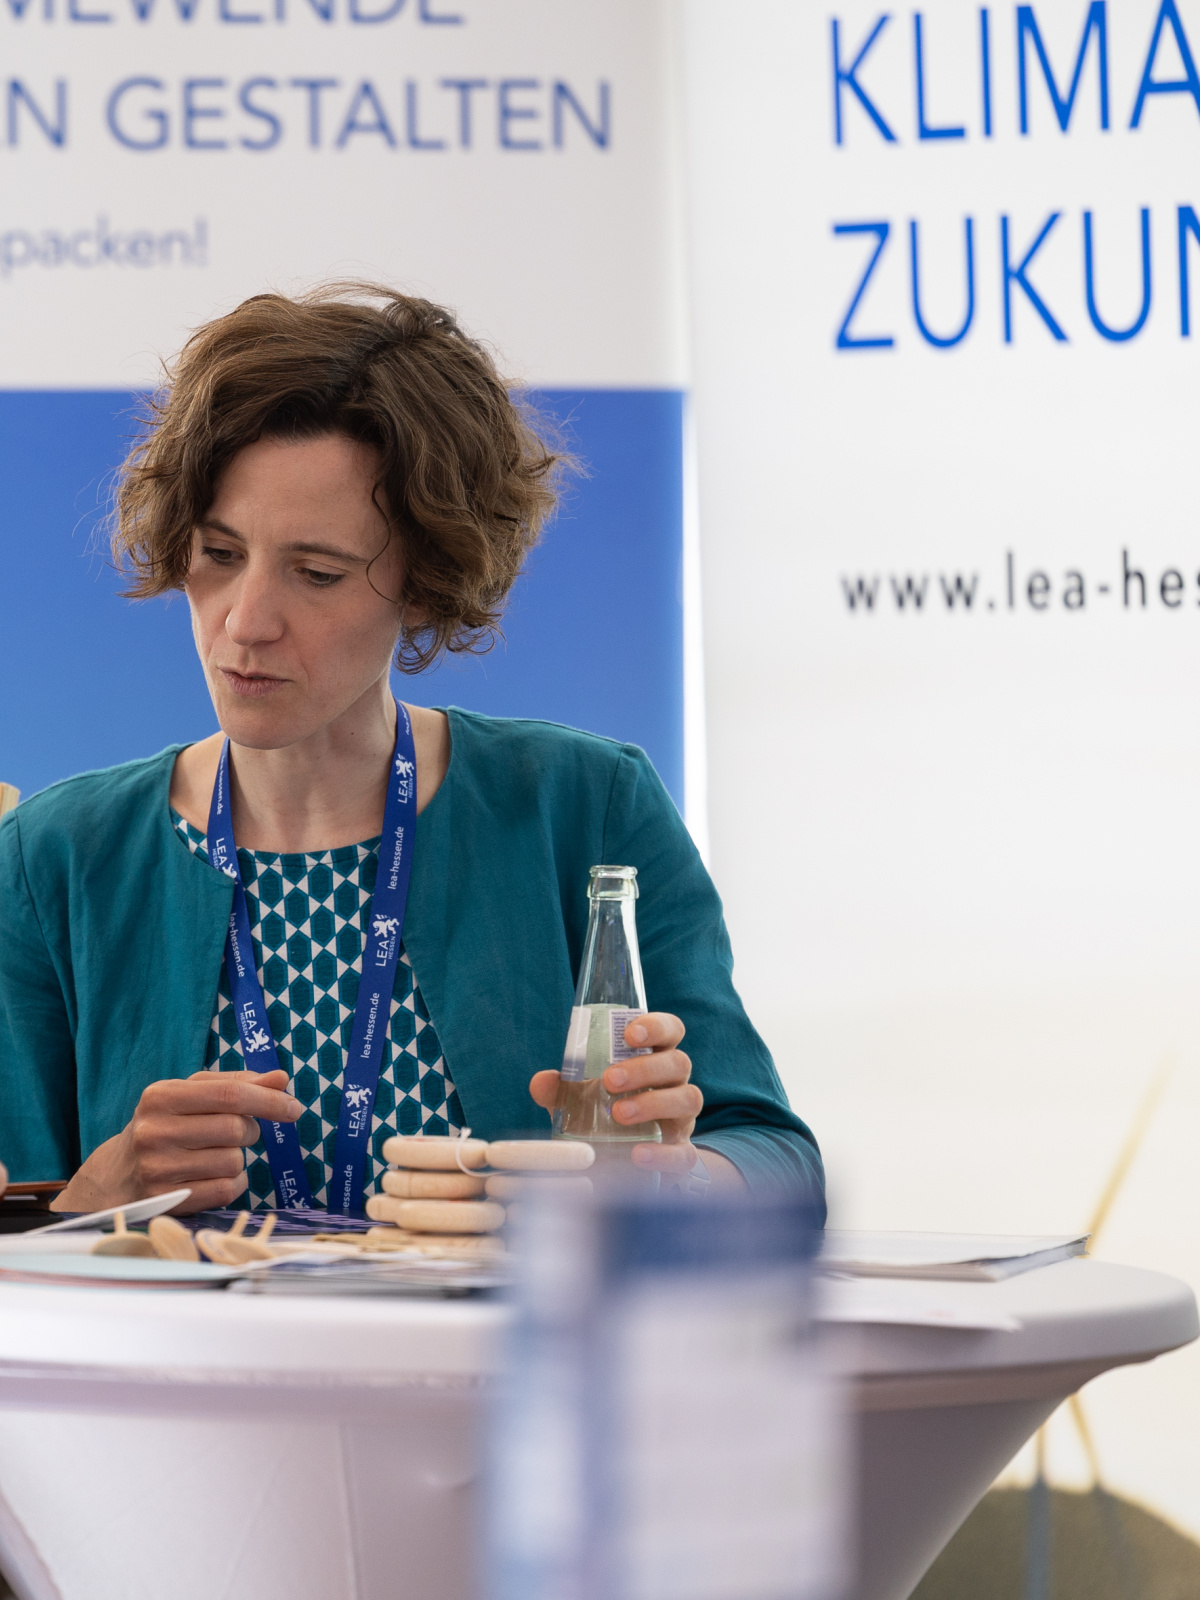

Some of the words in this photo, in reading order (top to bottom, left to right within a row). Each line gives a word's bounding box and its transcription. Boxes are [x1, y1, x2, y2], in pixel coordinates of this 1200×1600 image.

[829, 0, 1200, 147] KLIMA
[104, 74, 613, 153] GESTALTEN
[398, 779, 409, 804] LEA
[215, 838, 228, 865] LEA
[387, 826, 404, 890] lea-hessen.de
[229, 912, 246, 978] lea-hessen.de
[375, 940, 390, 967] LEA
[388, 936, 396, 960] HESSEN
[240, 1012, 249, 1036] HESSEN
[243, 1001, 257, 1030] LEA
[360, 992, 380, 1059] lea-hessen.de
[347, 1110, 362, 1138] LEA
[360, 1105, 368, 1131] HESSEN
[283, 1169, 298, 1198] LEA
[343, 1164, 353, 1210] essen.de
